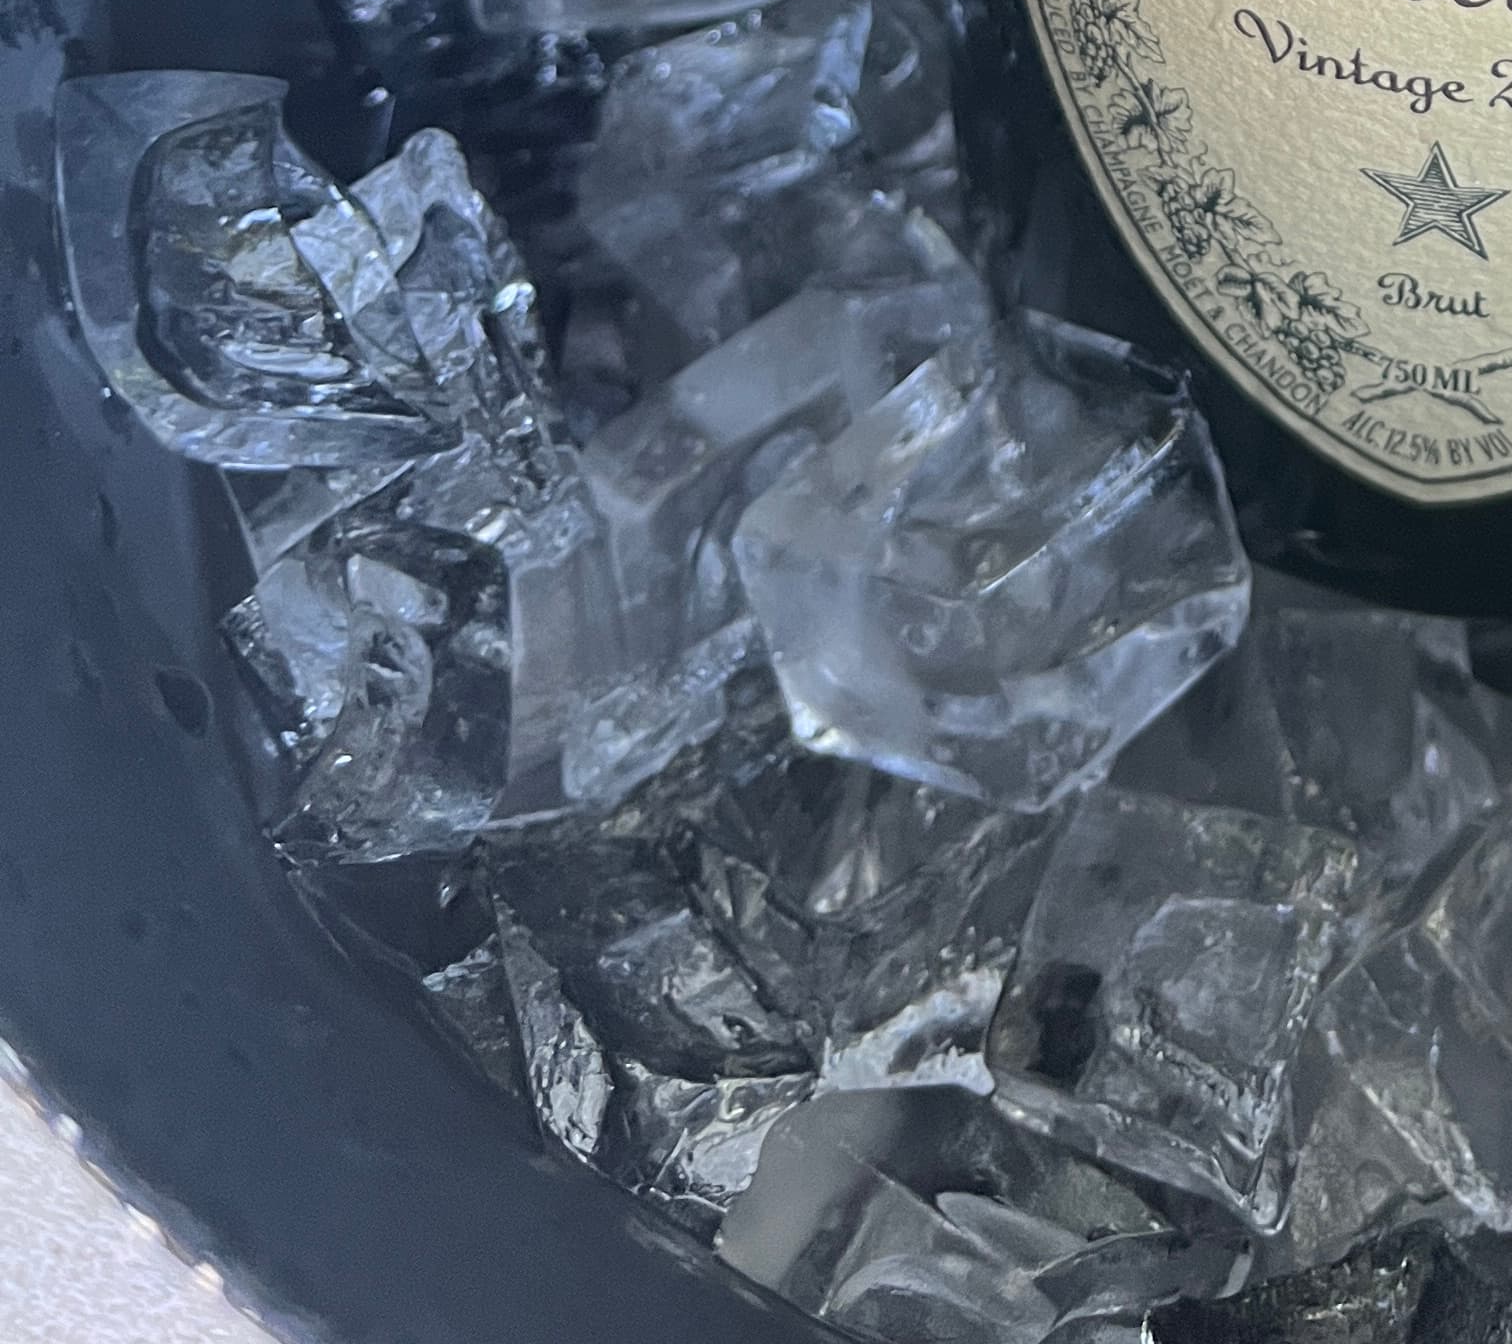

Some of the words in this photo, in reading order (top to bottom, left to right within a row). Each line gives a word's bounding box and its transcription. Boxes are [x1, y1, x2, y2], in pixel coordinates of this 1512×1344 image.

[1233, 9, 1473, 113] Vintage
[1069, 70, 1095, 97] BY
[1082, 105, 1164, 235] CHAMPAGNE
[1224, 322, 1330, 416] CHANDON
[1377, 272, 1489, 318] Brut
[1448, 438, 1474, 466] BY
